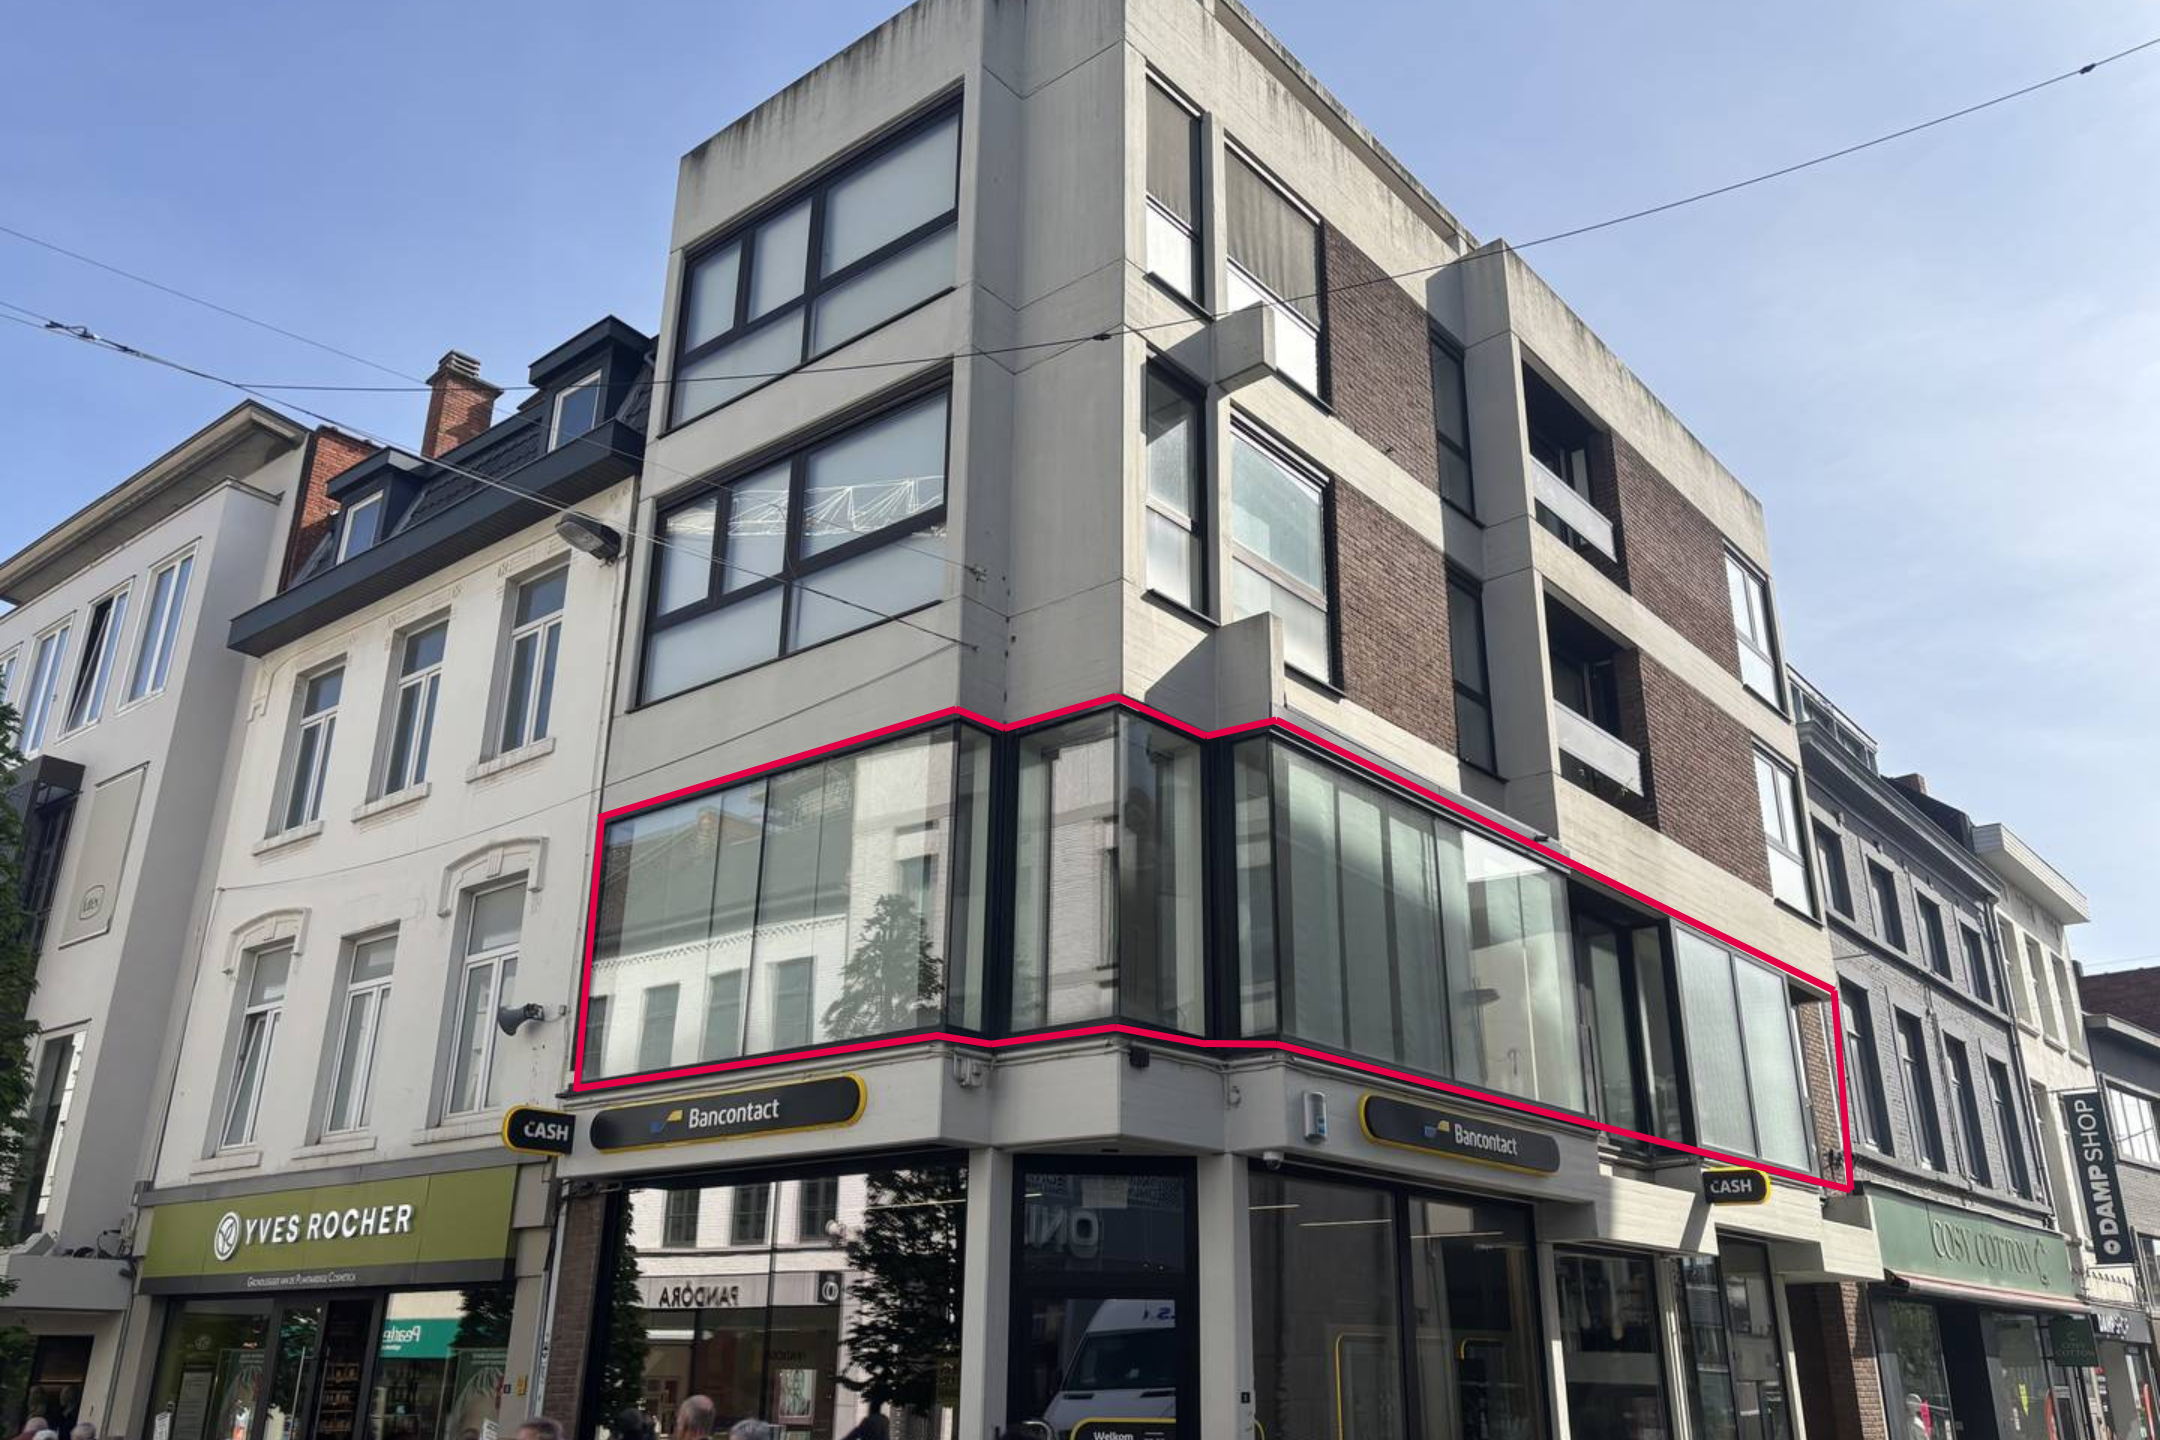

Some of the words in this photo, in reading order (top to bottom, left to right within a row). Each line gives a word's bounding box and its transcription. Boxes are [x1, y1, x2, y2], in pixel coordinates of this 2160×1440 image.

[523, 1120, 570, 1142] CASH
[688, 1099, 780, 1129] Bancontact
[1454, 1122, 1519, 1156] Bancontact
[2074, 1099, 2120, 1236] DAMPSHOP
[1710, 1178, 1753, 1194] CASH
[244, 1214, 301, 1246] YVES
[306, 1203, 413, 1241] ROCHER
[1932, 1220, 1971, 1263] COSY
[1975, 1232, 2032, 1274] COTTON
